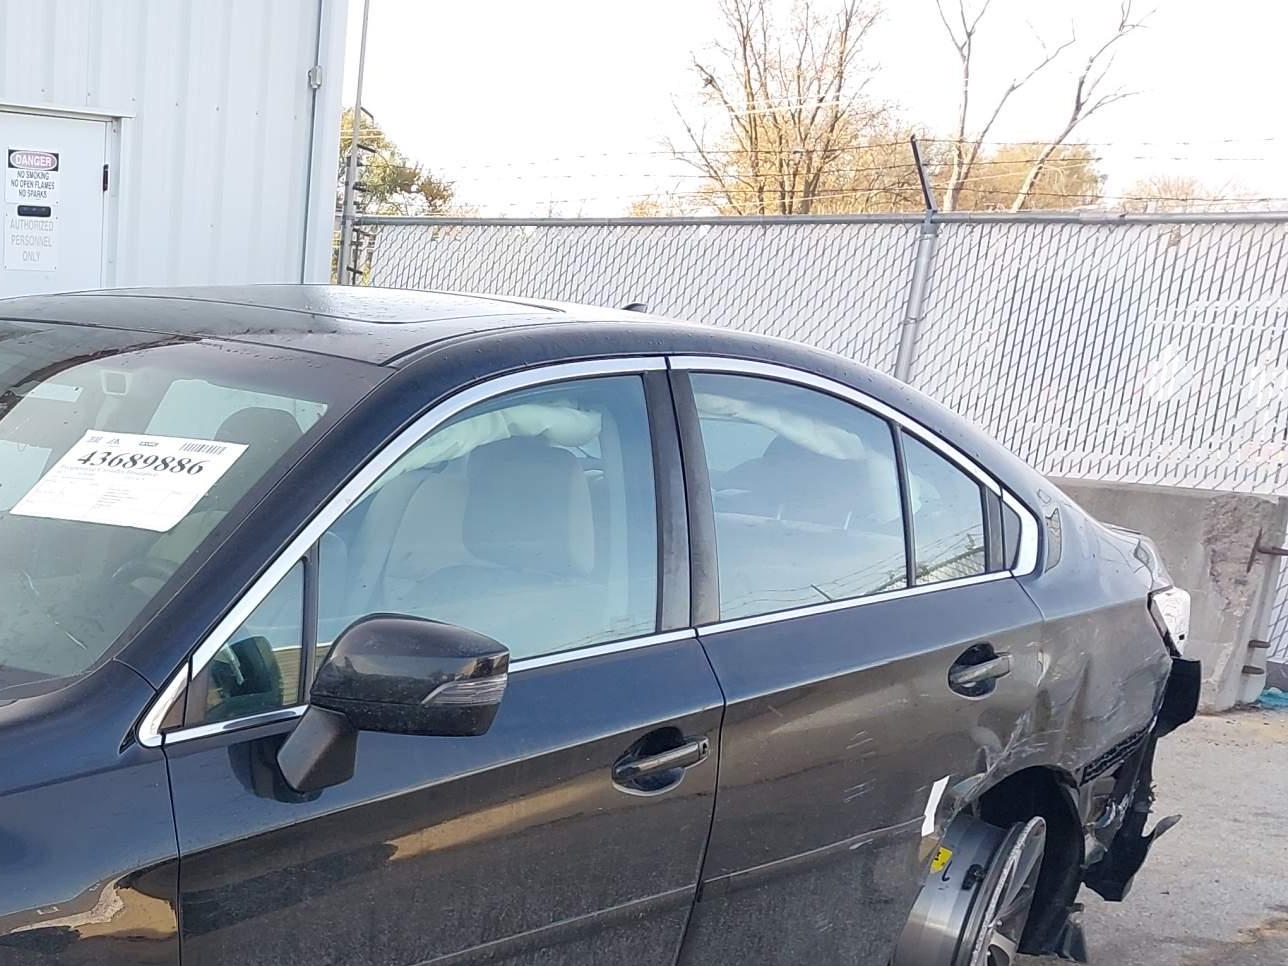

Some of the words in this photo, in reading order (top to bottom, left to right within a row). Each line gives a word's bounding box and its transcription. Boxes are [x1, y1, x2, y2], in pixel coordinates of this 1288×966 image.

[15, 154, 52, 167] DANGER
[17, 170, 25, 179] NO
[26, 171, 50, 180] SMOKING
[11, 179, 19, 188] NO
[20, 180, 34, 189] OPEN
[35, 180, 55, 190] FLAMES
[19, 188, 26, 198] NO
[27, 189, 48, 199] SPARKS
[10, 218, 54, 232] AUTHORIZED
[11, 234, 53, 247] PERSONNEL
[22, 250, 41, 262] ONLY
[77, 450, 211, 476] 43689886
